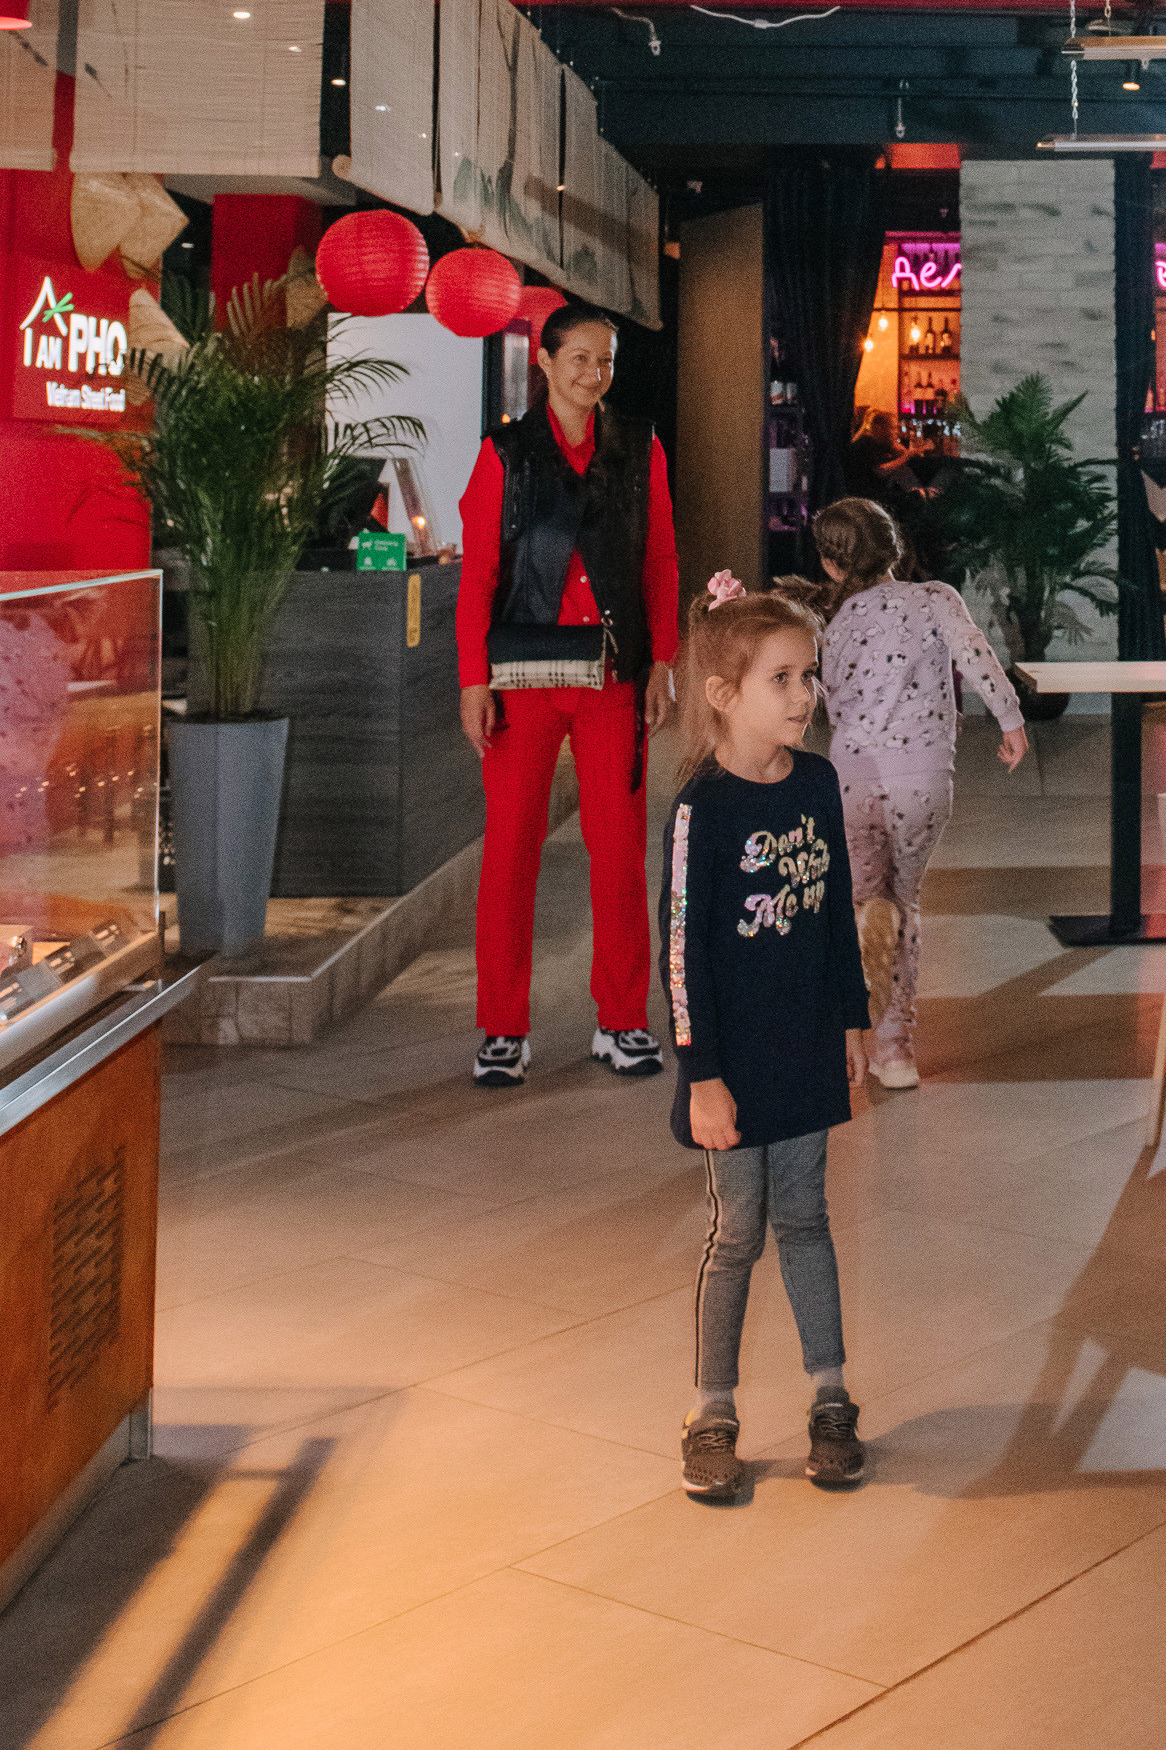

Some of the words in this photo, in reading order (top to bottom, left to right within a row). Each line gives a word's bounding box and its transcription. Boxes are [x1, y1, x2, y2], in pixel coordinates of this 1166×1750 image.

[23, 327, 34, 368] I
[36, 334, 63, 371] AM
[68, 313, 128, 376] PHO
